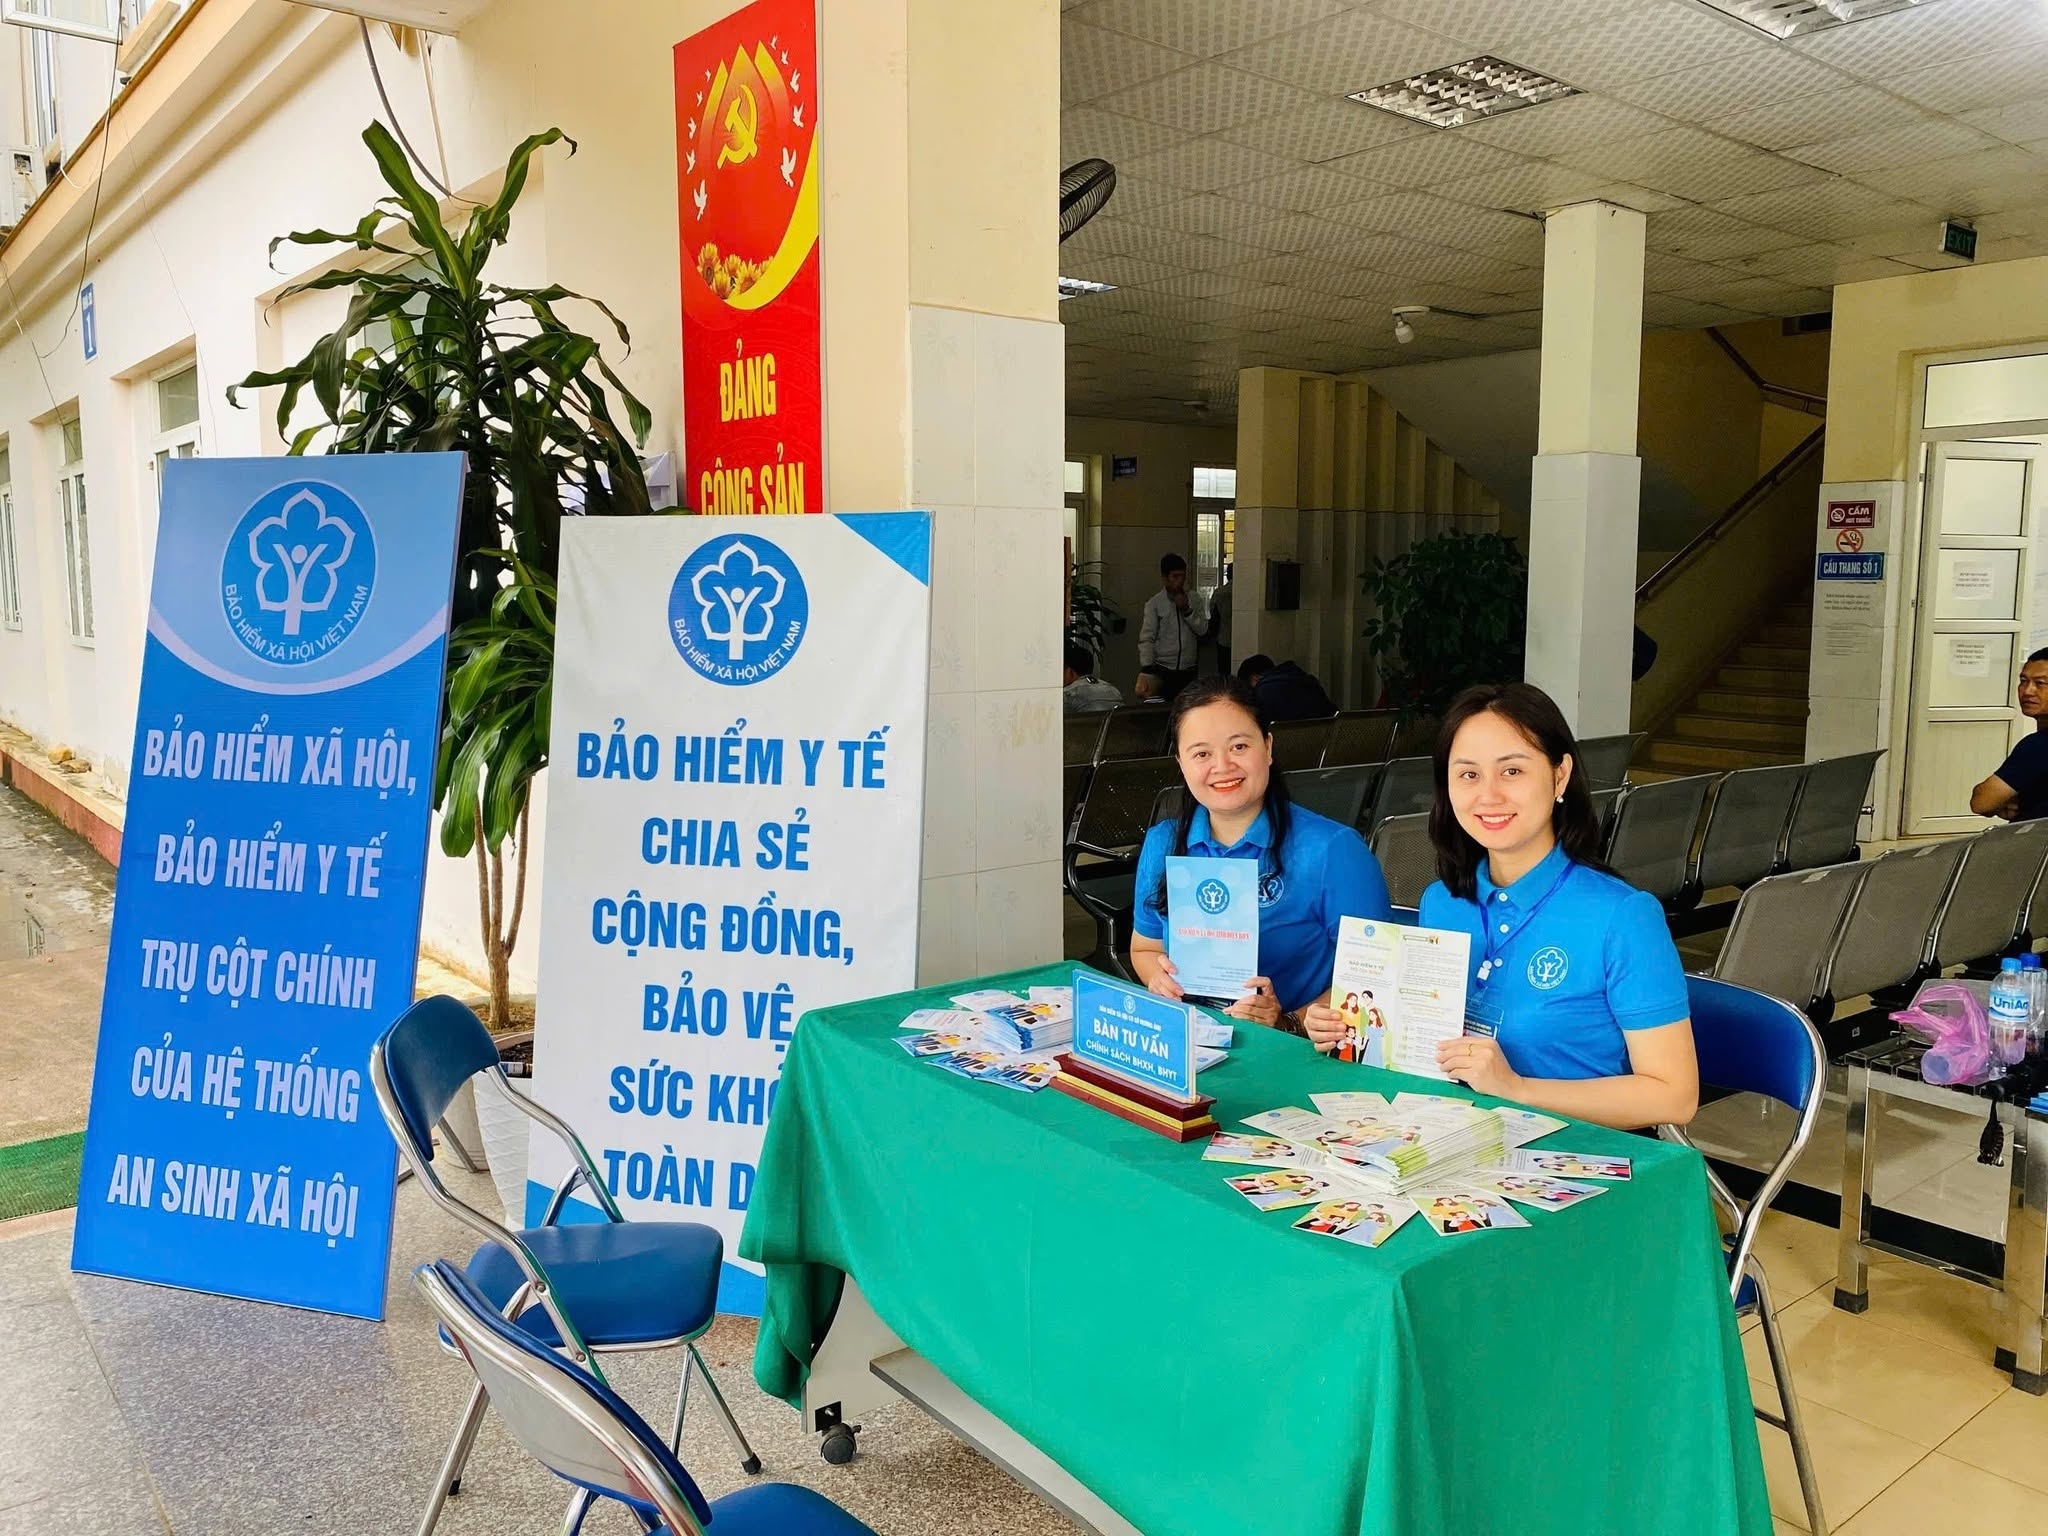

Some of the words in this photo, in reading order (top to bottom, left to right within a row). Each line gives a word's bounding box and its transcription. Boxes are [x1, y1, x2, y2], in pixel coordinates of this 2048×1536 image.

[1947, 230, 1973, 254] EXIT
[720, 338, 776, 422] ĐẢNG
[702, 457, 754, 515] CÔNG
[760, 442, 804, 515] SẢN
[1838, 562, 1861, 574] THANG
[1874, 562, 1878, 574] 1
[224, 584, 242, 620] BẢO
[236, 618, 266, 652] HIỂM
[266, 642, 284, 660] XÃ
[290, 641, 315, 662] HỘI
[316, 620, 346, 651] VIỆT
[343, 584, 368, 624] NAM
[674, 618, 692, 646] BẢO
[686, 646, 715, 674] HIỂM
[714, 665, 732, 680] XÃ
[736, 665, 758, 681] HỘI
[758, 649, 785, 673] VIỆT
[781, 620, 801, 651] NAM
[142, 714, 205, 779] BẢO
[212, 714, 294, 783] HIỂM
[300, 727, 346, 786] XÃ
[353, 728, 416, 800] HỘI,
[576, 718, 660, 781] BẢO
[674, 718, 784, 786] HIỂM
[800, 739, 824, 786] Y
[838, 726, 890, 789] TẾ
[154, 819, 217, 886] BẢO
[224, 821, 307, 892] HIỂM
[318, 844, 337, 894] Y
[346, 831, 388, 898] TẾ
[642, 817, 740, 868] CHIA
[756, 807, 810, 871] SẺ
[592, 889, 706, 957] CỘNG
[720, 890, 854, 966] ĐỒNG,
[141, 938, 199, 1003] TRỤ
[206, 936, 268, 1008] CỘT
[274, 944, 376, 1010] CHÍNH
[642, 970, 728, 1036] BẢO
[742, 983, 794, 1052] VỆ
[1094, 1018, 1118, 1041] BÀN
[1122, 1028, 1138, 1048] TƯ
[1140, 1034, 1168, 1060] VẤN
[131, 1032, 192, 1102] CỦA
[201, 1046, 244, 1120] HỆ
[254, 1046, 361, 1122] THỐNG
[608, 1059, 694, 1120] SỨC
[708, 1064, 785, 1126] KH
[1086, 1040, 1108, 1055] CHÍNH
[1110, 1047, 1131, 1063] SÁCH
[1132, 1056, 1156, 1074] BHXH,
[1158, 1065, 1177, 1080] BHYT
[106, 1154, 155, 1208] AN
[161, 1160, 241, 1220] SINH
[246, 1165, 292, 1228] XÃ
[300, 1172, 359, 1248] HỘI
[604, 1144, 714, 1208] TOÀN
[728, 1162, 756, 1211] D
